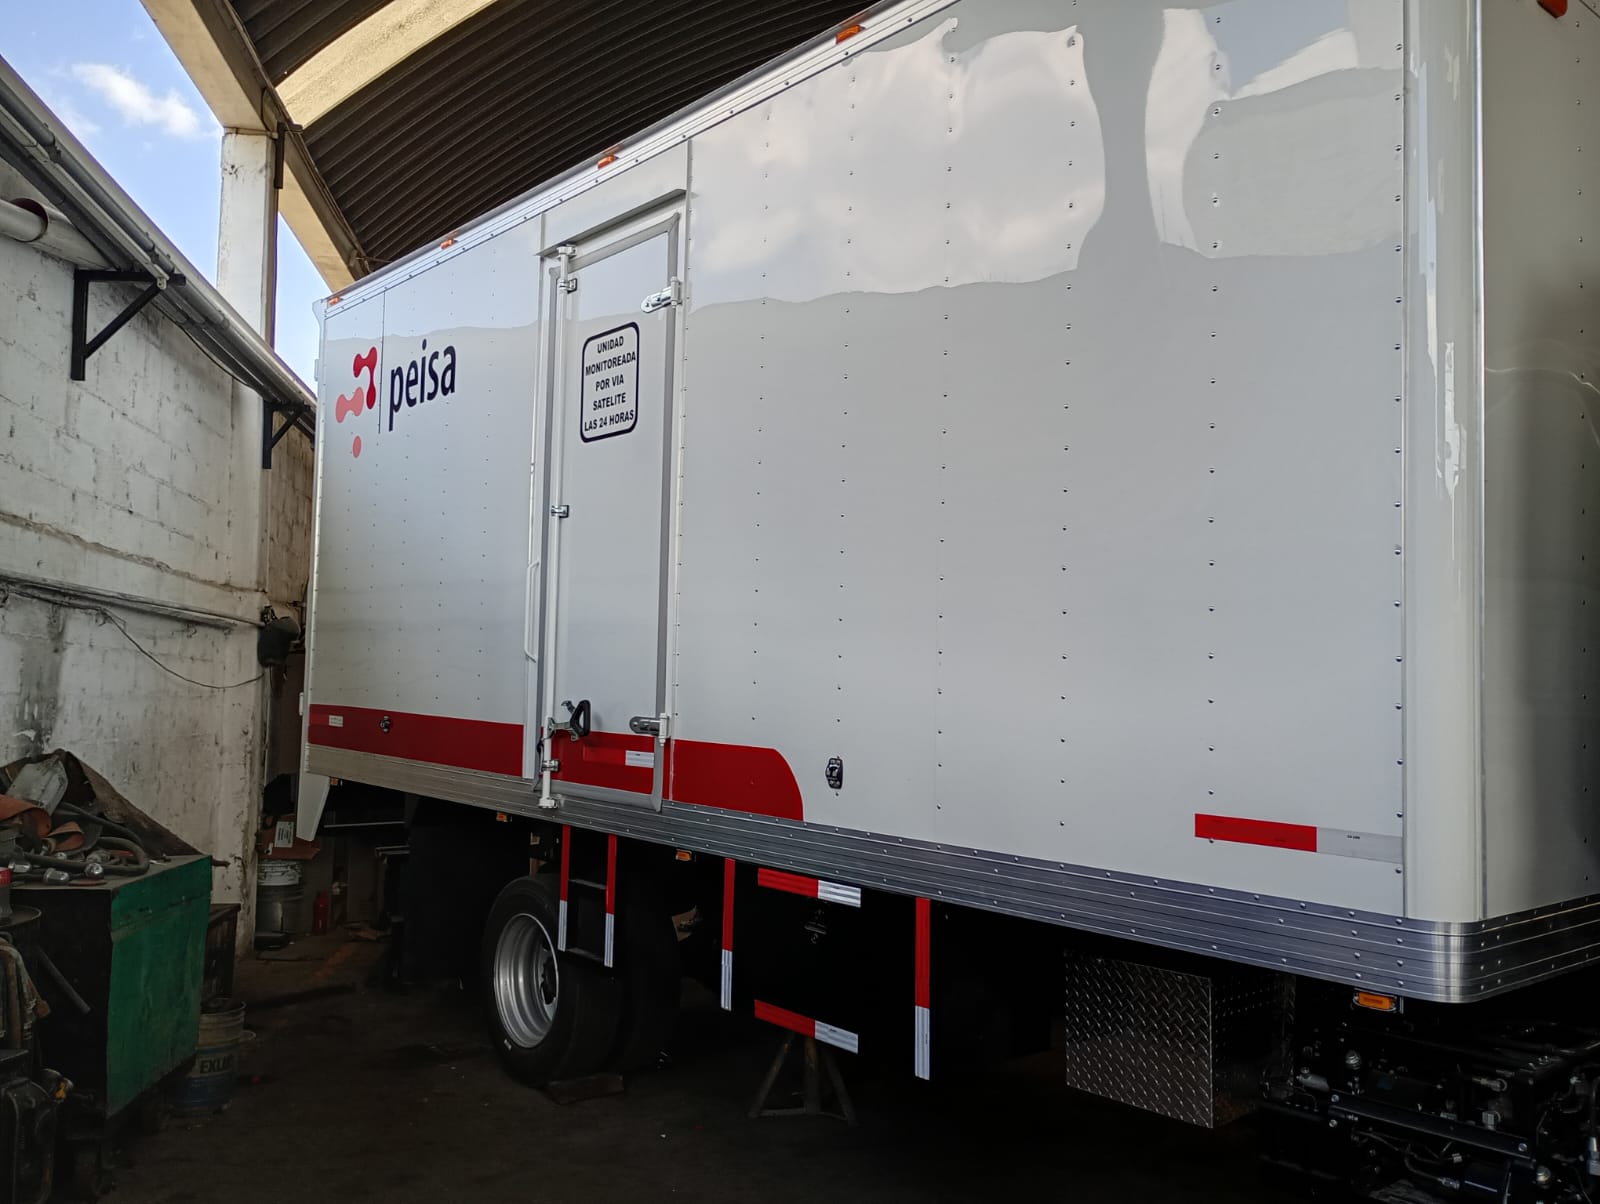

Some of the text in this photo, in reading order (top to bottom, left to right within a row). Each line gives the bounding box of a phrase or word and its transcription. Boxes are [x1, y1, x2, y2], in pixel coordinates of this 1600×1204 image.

[597, 335, 624, 354] UNIDAD
[585, 351, 636, 376] MONITOREADA
[388, 338, 457, 432] peisa
[595, 374, 624, 392] POR VIA
[593, 392, 626, 411] SATELITE
[584, 409, 634, 431] LAS 24 HORAS
